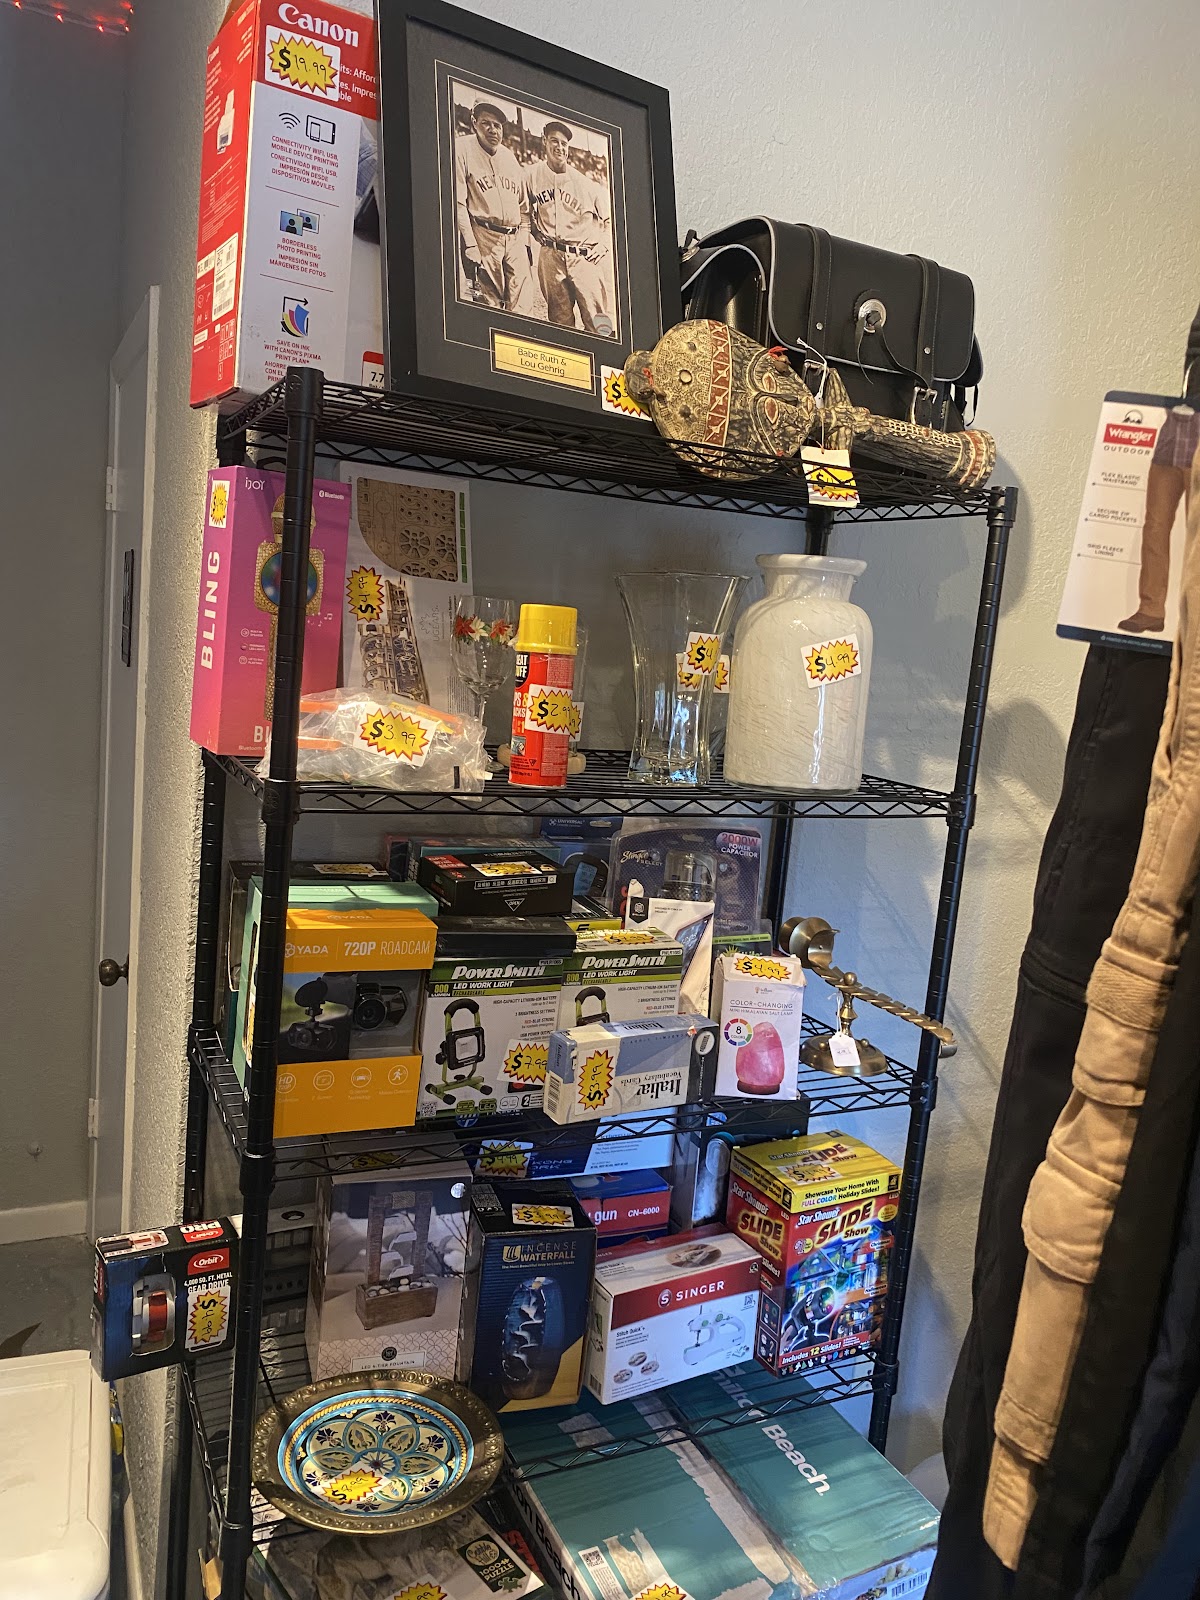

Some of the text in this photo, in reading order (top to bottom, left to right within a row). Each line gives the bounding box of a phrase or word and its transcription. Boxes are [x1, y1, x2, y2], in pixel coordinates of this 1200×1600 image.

[278, 3, 359, 48] Canon
[278, 46, 327, 81] $19.99
[271, 143, 339, 168] MOBILE DEVICE PRINTING
[272, 136, 311, 152] CONNECTIVITY
[326, 152, 338, 161] USB,
[271, 153, 310, 169] CONECTIVIDAD
[326, 169, 338, 178] USB,
[280, 163, 329, 182] IMPRESIÓN DESDE
[272, 169, 335, 191] DISPOSITIVOS MÓVILES
[476, 175, 521, 197] NEW YORK
[536, 189, 582, 216] NEW YORK
[277, 244, 321, 260] PHOTO PRINTING
[281, 238, 317, 251] BORDERLESS
[278, 253, 319, 269] IMPRESIÓN SIN
[309, 268, 327, 278] FOTOS
[264, 344, 322, 361] WITH CANON'S PIXMA
[277, 340, 291, 348] SAVE
[275, 354, 291, 362] PRINT
[517, 348, 539, 359] Babe
[540, 353, 559, 364] Ruth
[265, 361, 287, 370] AHORRE
[520, 357, 565, 377] Lou Gehrig
[1109, 427, 1153, 444] Wrangler
[1104, 445, 1151, 455] OUTDOOR
[1103, 477, 1137, 485] WAISTBAND
[1111, 515, 1137, 523] POCKETS
[358, 576, 376, 615] $4.99
[201, 551, 220, 670] BLING
[814, 652, 850, 674] $4.99
[537, 699, 570, 719] $2.99
[370, 719, 416, 746] $3.99
[722, 833, 759, 846] 2000W
[620, 850, 648, 863] Stinger
[721, 847, 758, 858] CAPACITOR
[298, 940, 431, 956] YADA 720P ROADCAM
[743, 961, 780, 975] $4.99
[566, 973, 579, 982] 800
[435, 984, 449, 993] 800
[623, 1022, 665, 1031] Italian
[736, 1026, 742, 1034] 8
[279, 1076, 293, 1084] HD
[587, 1062, 604, 1102] $3.99
[620, 1071, 681, 1087] Vocabulary Cards
[801, 1144, 848, 1162] SLIDE
[833, 1154, 857, 1163] Show
[801, 1186, 880, 1207] FULL COLOR Holiday Slides!
[805, 1179, 880, 1199] Showcase Your Home With
[731, 1182, 769, 1215] Star Shower
[595, 1206, 660, 1225] gun CN-6000
[798, 1208, 840, 1225] Star Shower
[816, 1200, 874, 1245] SLIDE
[740, 1213, 783, 1241] SLIDE
[760, 1211, 790, 1256] Show LED
[845, 1227, 870, 1239] Show
[521, 1241, 577, 1253] INCENSE
[199, 1257, 218, 1266] Orbit
[521, 1252, 575, 1262] WATERFALL
[184, 1277, 198, 1287] 4,000
[217, 1272, 233, 1281] METAL
[188, 1279, 230, 1293] GEAR DRIVE
[676, 1280, 725, 1301] SINGER
[201, 1298, 218, 1338] $4.99
[616, 1330, 629, 1338] Stitch
[782, 1342, 842, 1365] Includes 12 Slides!
[761, 1423, 831, 1497] Beach
[467, 1542, 491, 1559] Cobble
[535, 1516, 581, 1600] Beach
[484, 1562, 515, 1581] PUZZLE
